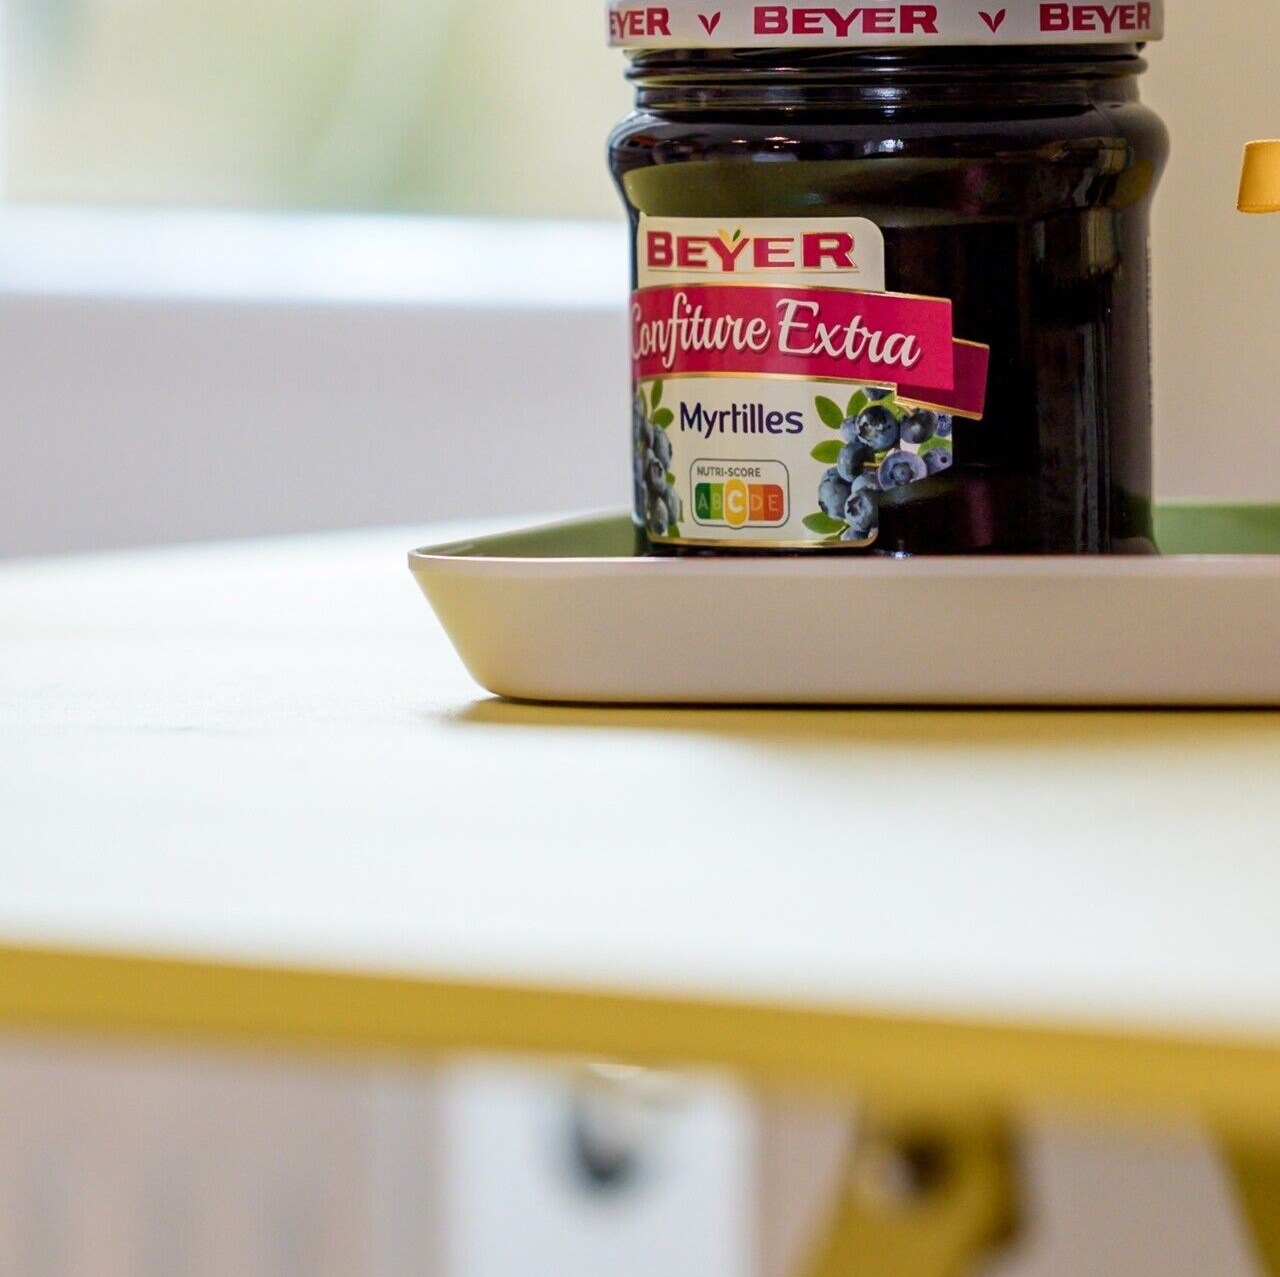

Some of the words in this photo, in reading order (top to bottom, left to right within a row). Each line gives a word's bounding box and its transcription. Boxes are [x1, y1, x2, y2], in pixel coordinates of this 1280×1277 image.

[609, 8, 671, 39] EYER
[753, 5, 938, 37] BEYER
[1039, 1, 1151, 34] BEYER
[647, 230, 858, 272] BEYER
[632, 292, 771, 369] Confiture
[775, 298, 921, 367] Extra
[680, 401, 804, 439] Myrtilles
[696, 466, 761, 478] NUTRI-SCORE
